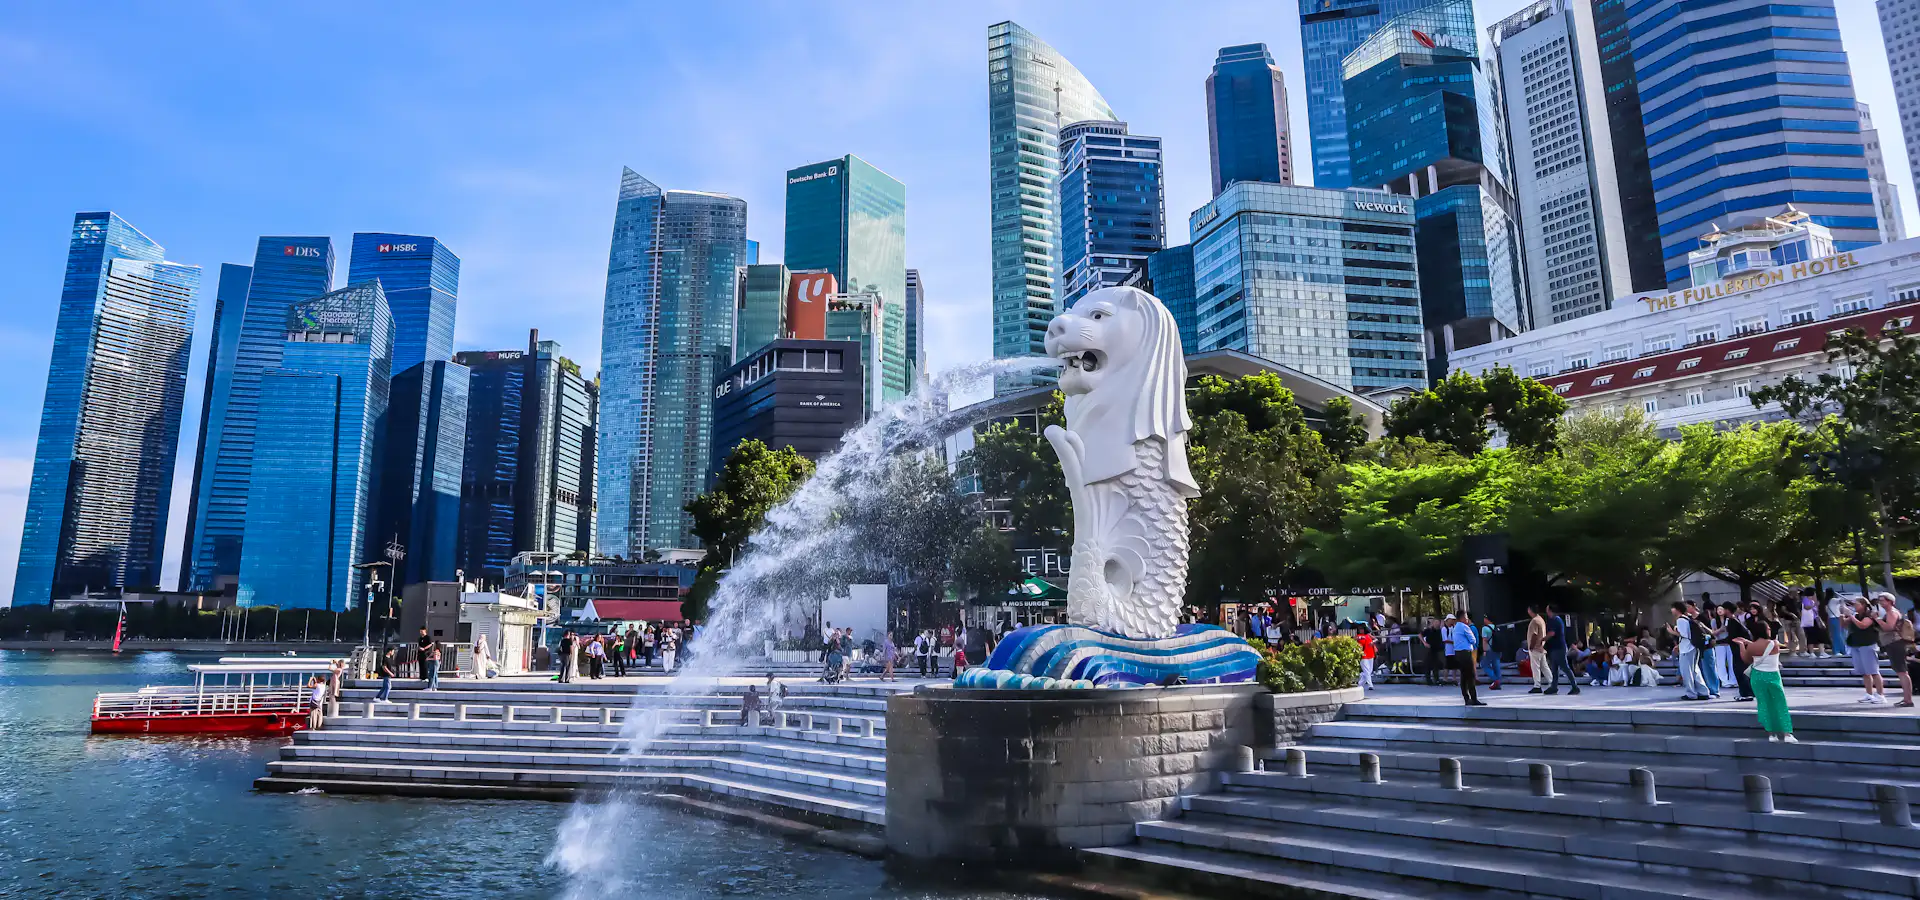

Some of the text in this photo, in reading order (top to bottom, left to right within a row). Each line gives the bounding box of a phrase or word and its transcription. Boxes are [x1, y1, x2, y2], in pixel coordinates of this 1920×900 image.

[790, 175, 813, 184] Deutsche
[1354, 200, 1408, 214] wework
[296, 246, 320, 257] DBS
[393, 244, 417, 252] HSBC
[1648, 253, 1859, 312] THE FULLERTON HOTEL
[715, 380, 731, 399] OUE
